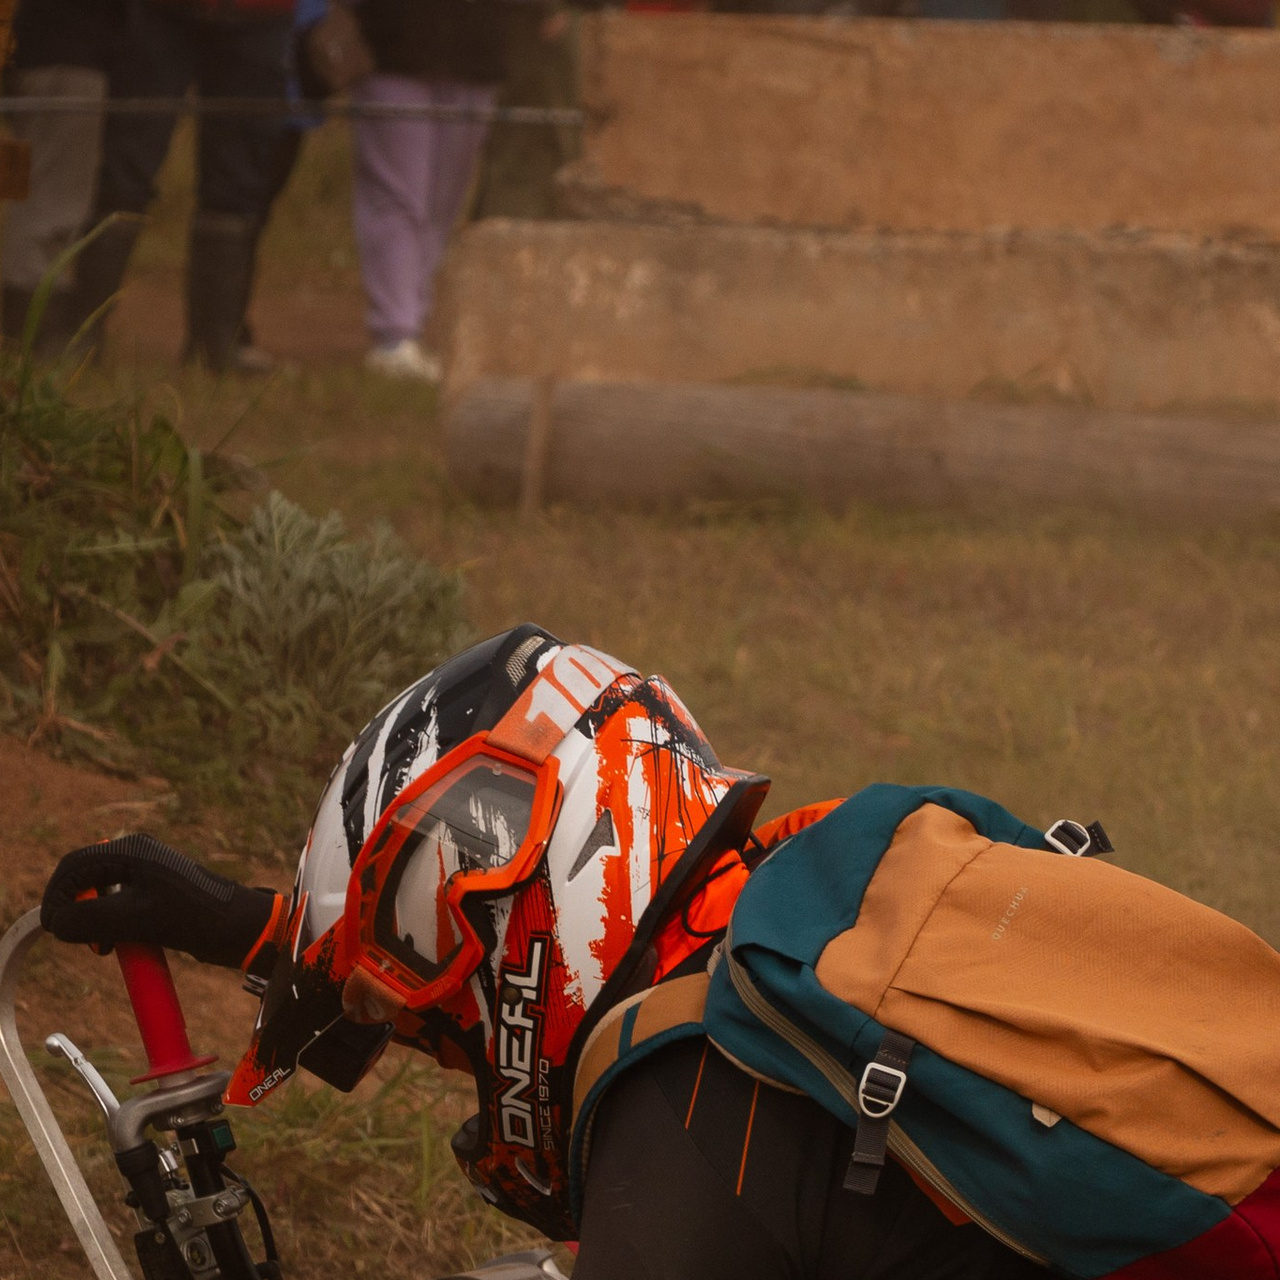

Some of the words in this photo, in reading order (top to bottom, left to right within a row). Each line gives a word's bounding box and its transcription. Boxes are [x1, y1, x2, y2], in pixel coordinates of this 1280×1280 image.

[992, 887, 1028, 940] QUECHUA
[249, 1067, 291, 1101] ONEAL
[538, 1058, 550, 1102] 1970
[539, 1103, 555, 1150] SINCE
